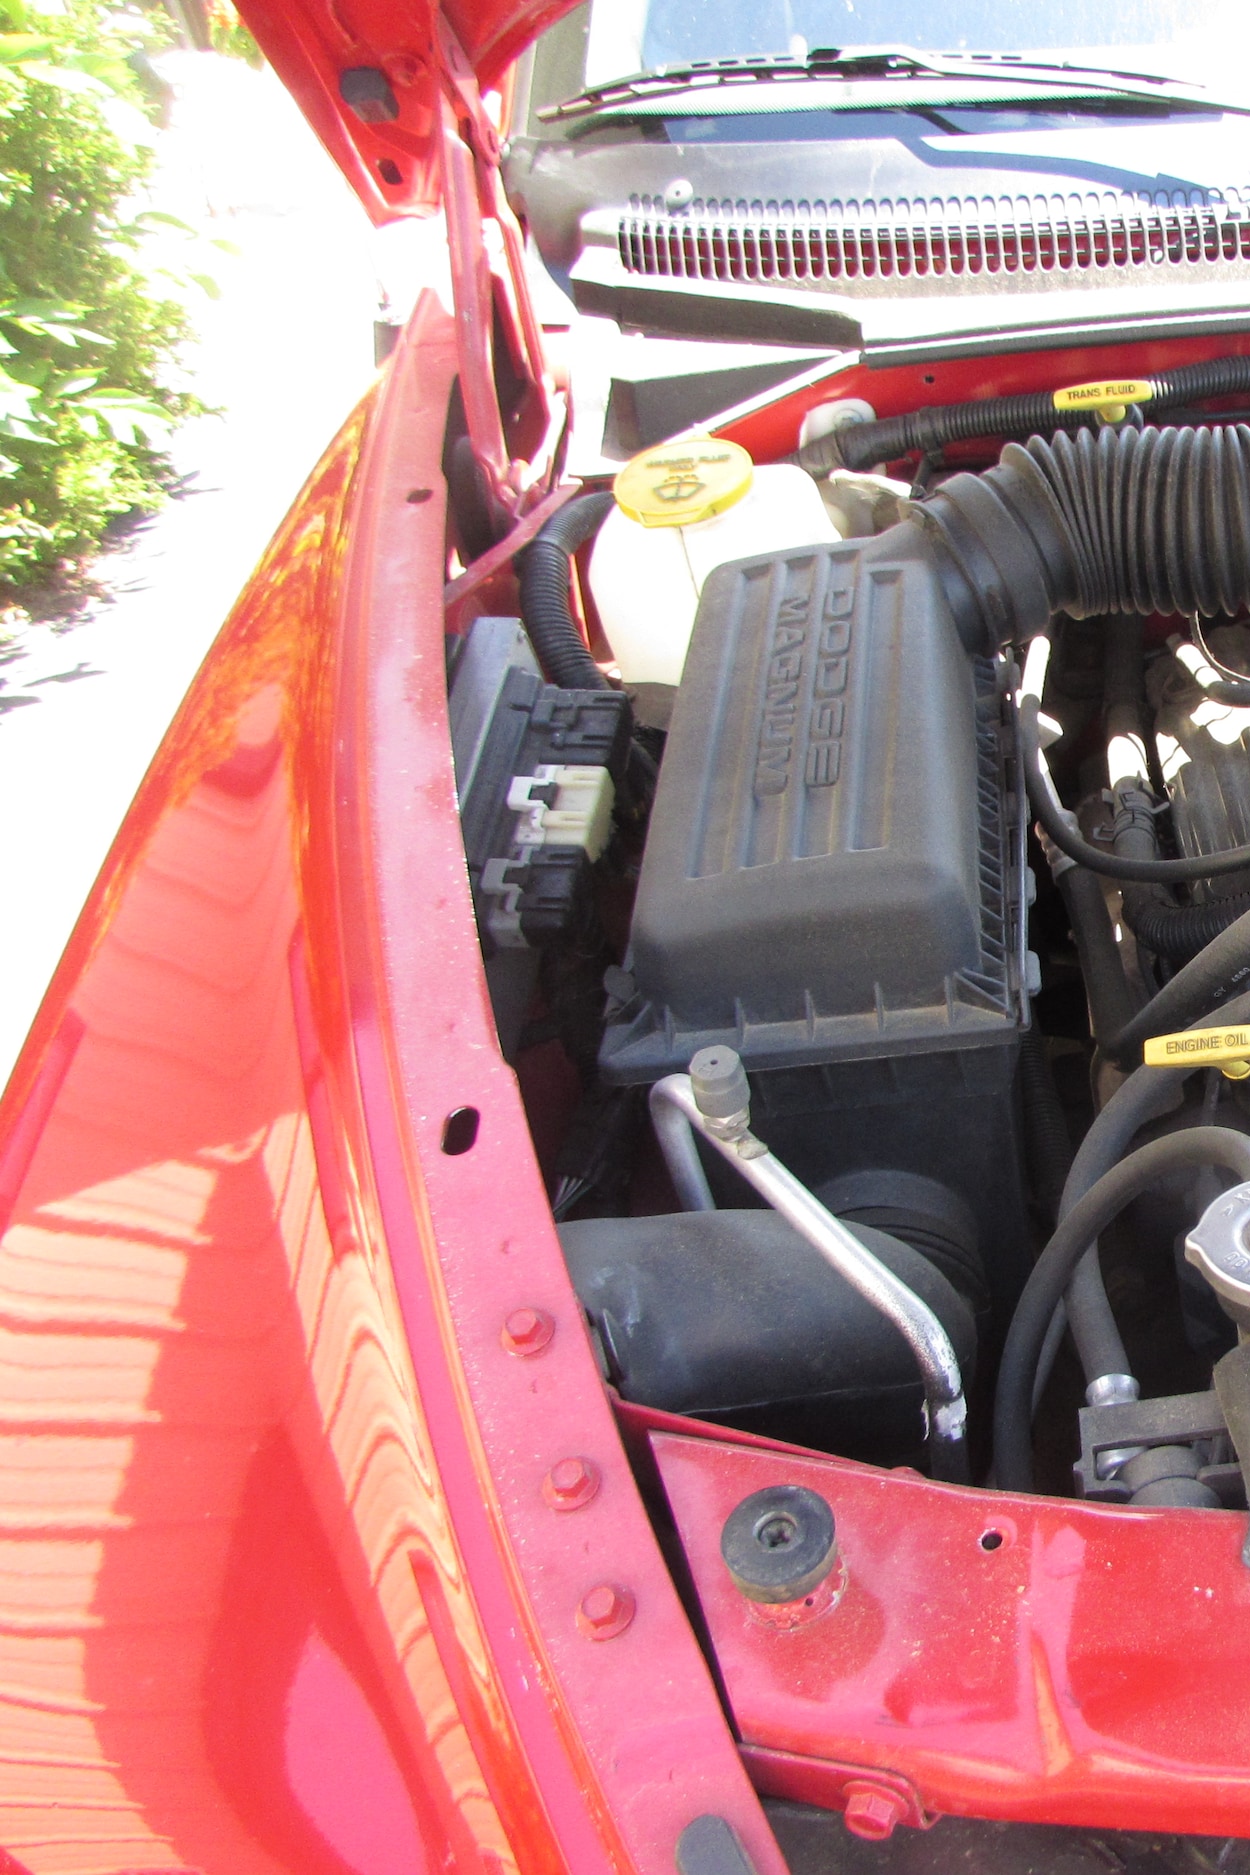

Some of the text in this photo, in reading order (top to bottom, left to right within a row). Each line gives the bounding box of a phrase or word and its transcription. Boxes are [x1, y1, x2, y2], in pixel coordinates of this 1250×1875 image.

[1066, 384, 1136, 401] TRANS FLUID
[753, 595, 810, 795] MAGNUM
[806, 587, 854, 787] DODGE
[1166, 1033, 1248, 1054] ENGINE OIL
[1224, 1251, 1248, 1270] DO
